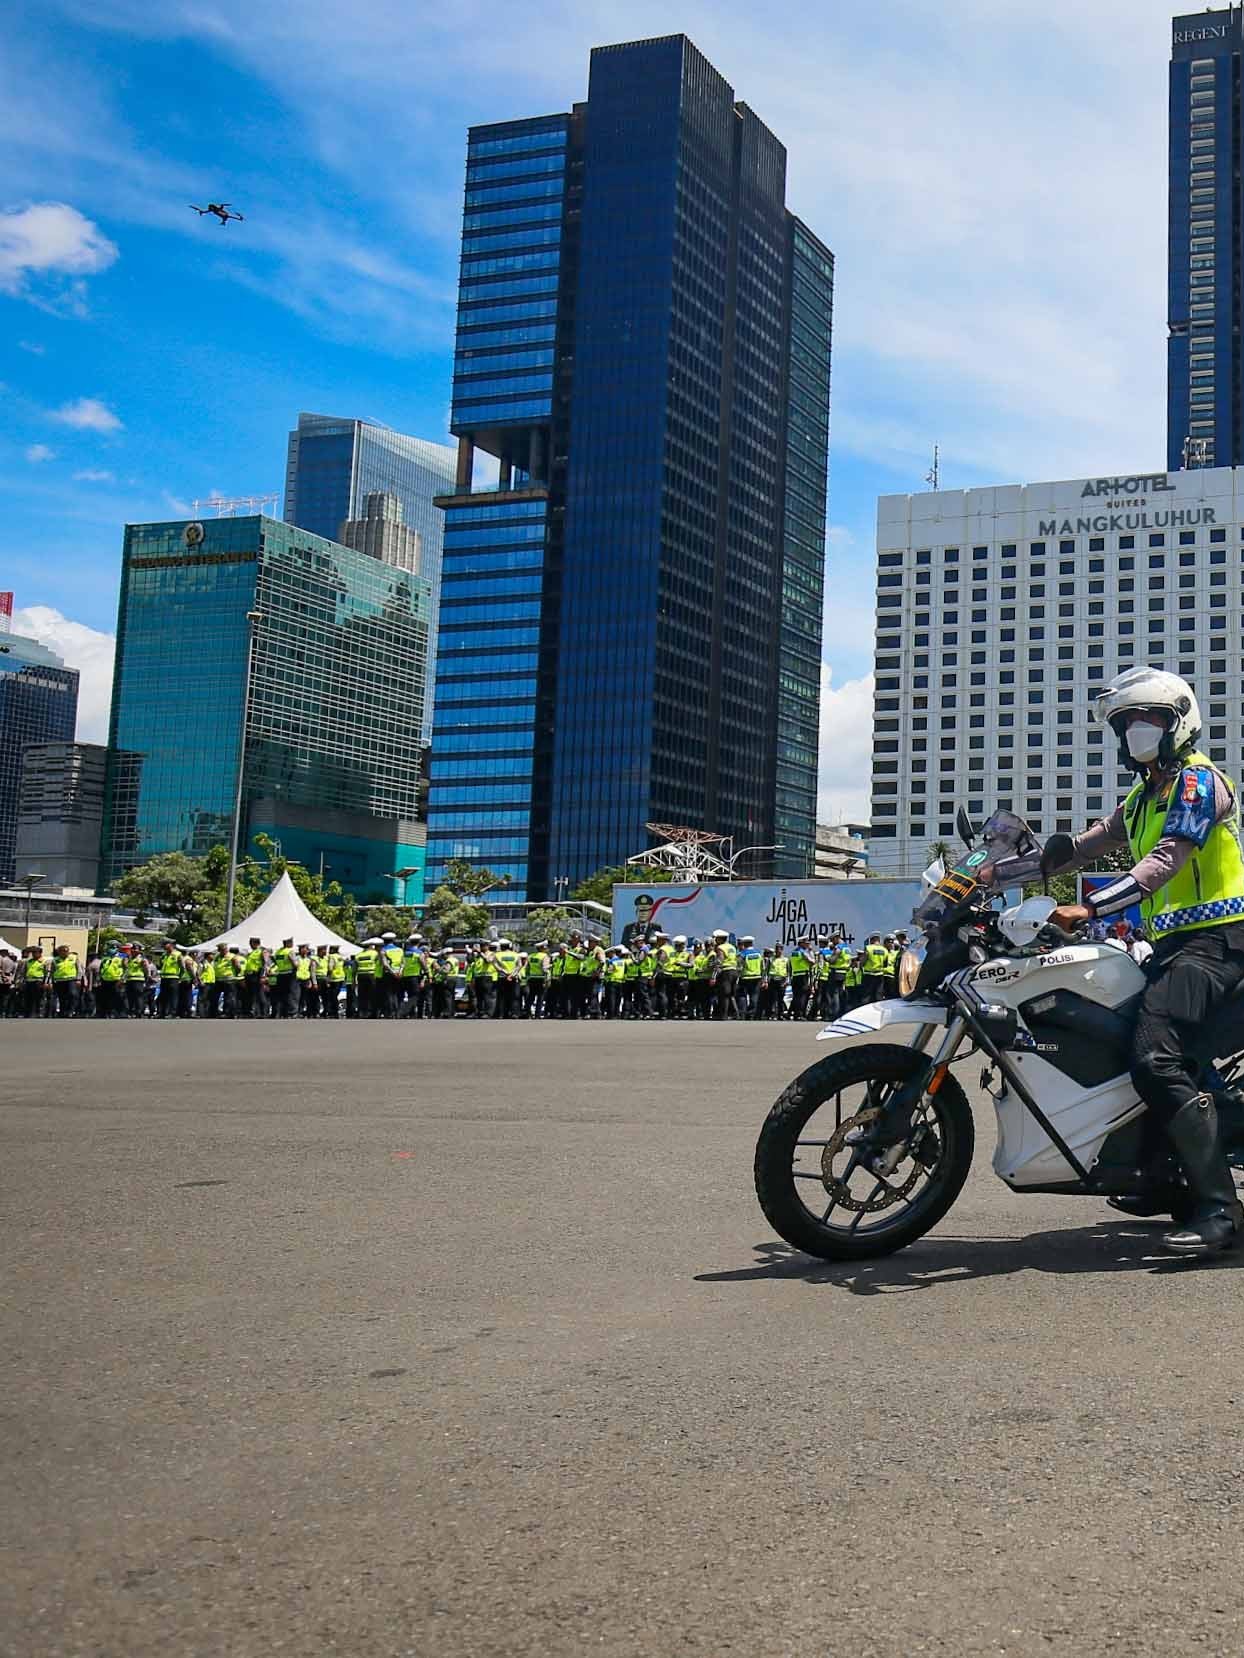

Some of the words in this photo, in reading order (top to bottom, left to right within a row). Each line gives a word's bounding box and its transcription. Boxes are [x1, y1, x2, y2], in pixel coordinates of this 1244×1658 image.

[1173, 25, 1229, 44] REGENT
[1106, 499, 1147, 509] SUITES
[1039, 508, 1216, 536] MANGKULUHUR
[766, 896, 808, 923] JAGA
[1039, 953, 1075, 967] POLISI
[969, 966, 1007, 982] ZERO
